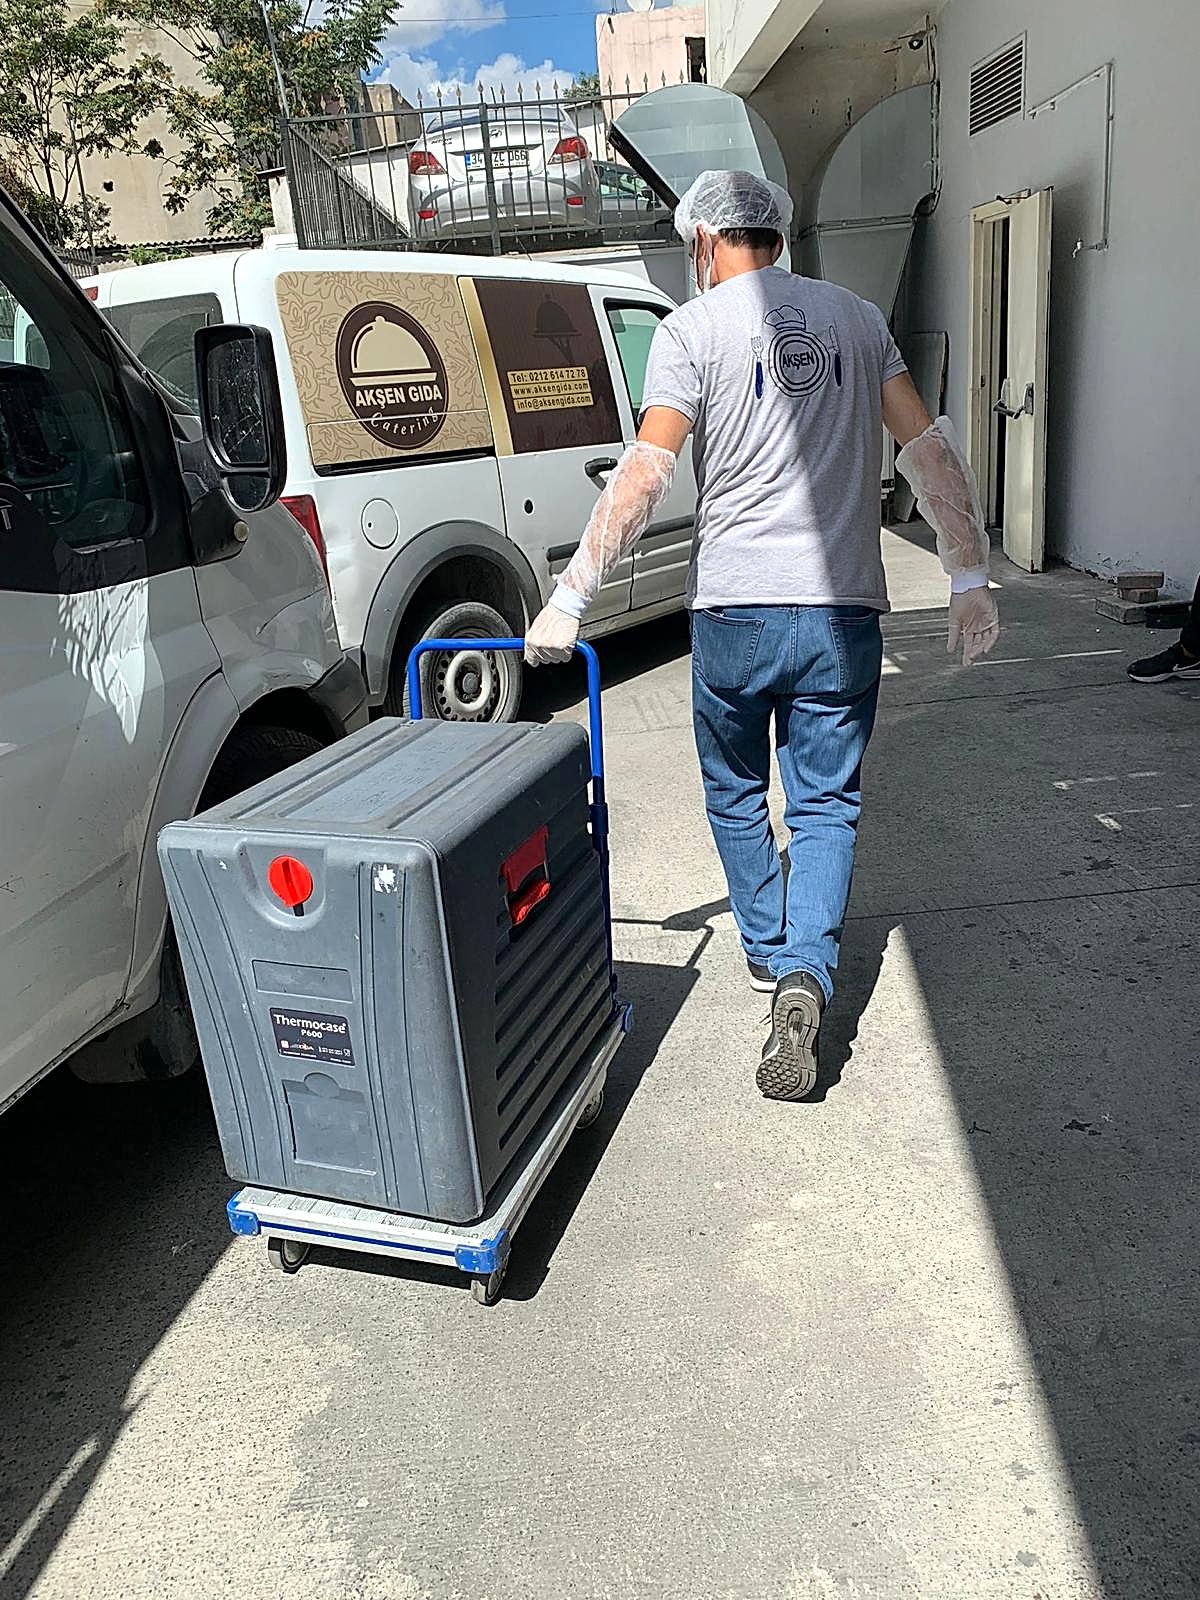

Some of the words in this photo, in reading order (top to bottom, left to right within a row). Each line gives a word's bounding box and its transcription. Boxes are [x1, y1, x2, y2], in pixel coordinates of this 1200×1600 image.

[471, 153, 483, 165] 34
[782, 351, 815, 370] AKŞEN
[511, 372, 528, 383] Tel:
[528, 371, 549, 381] 0212
[565, 369, 575, 379] 72
[576, 368, 586, 378] 78
[513, 382, 589, 395] www.aksengida.com
[355, 387, 406, 409] AKŞEN
[408, 385, 443, 402] GIDA
[517, 395, 592, 410] info@aksengida.com
[371, 406, 439, 435] Catering
[300, 1029, 323, 1039] P600
